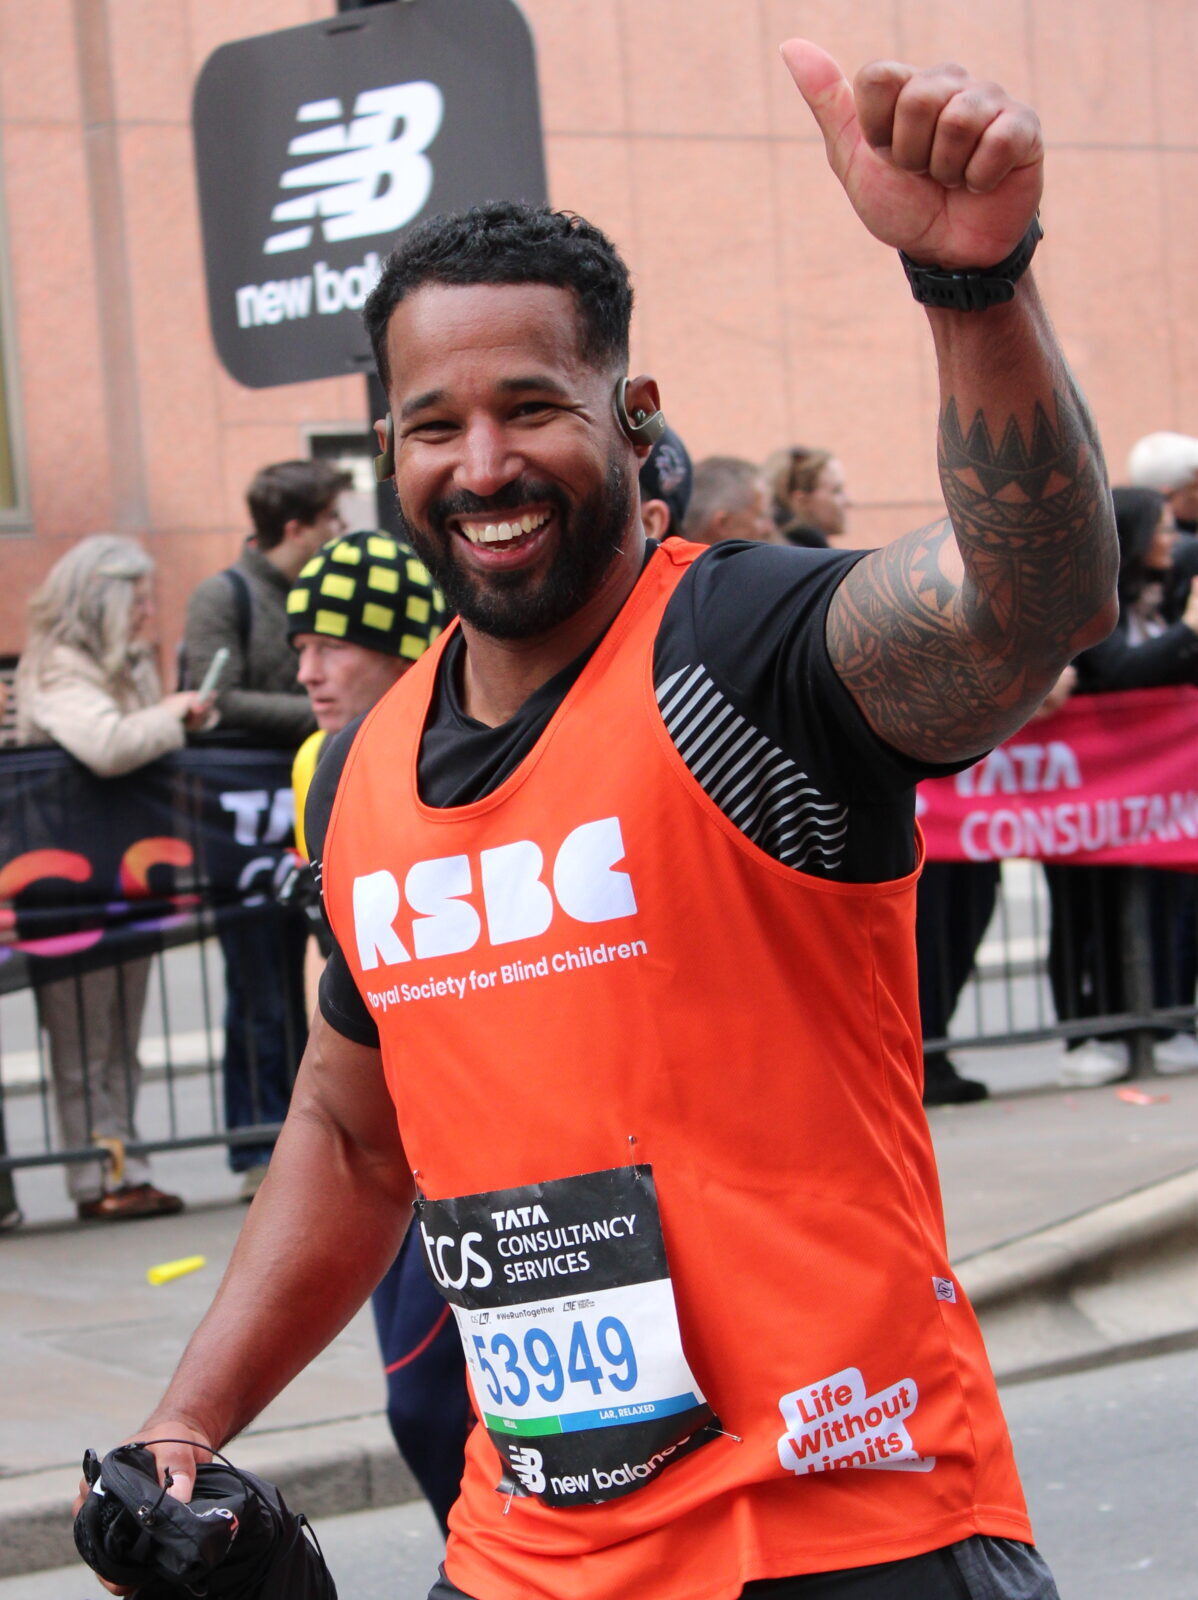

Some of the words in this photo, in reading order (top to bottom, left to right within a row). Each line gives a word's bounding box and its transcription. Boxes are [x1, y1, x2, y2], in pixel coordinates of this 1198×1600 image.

[235, 277, 313, 328] new
[353, 816, 638, 971] RSBC
[400, 975, 467, 1002] Society
[468, 968, 498, 990] for
[499, 955, 549, 985] Blind
[550, 939, 649, 973] Children
[491, 1204, 550, 1232] TATA
[497, 1214, 637, 1257] CONSULTANCY
[503, 1251, 591, 1284] SERVICES
[471, 1316, 639, 1407] 53949
[618, 1403, 656, 1418] RELAXED
[788, 1386, 911, 1460] Without
[796, 1384, 853, 1425] Life
[550, 1473, 590, 1495] new
